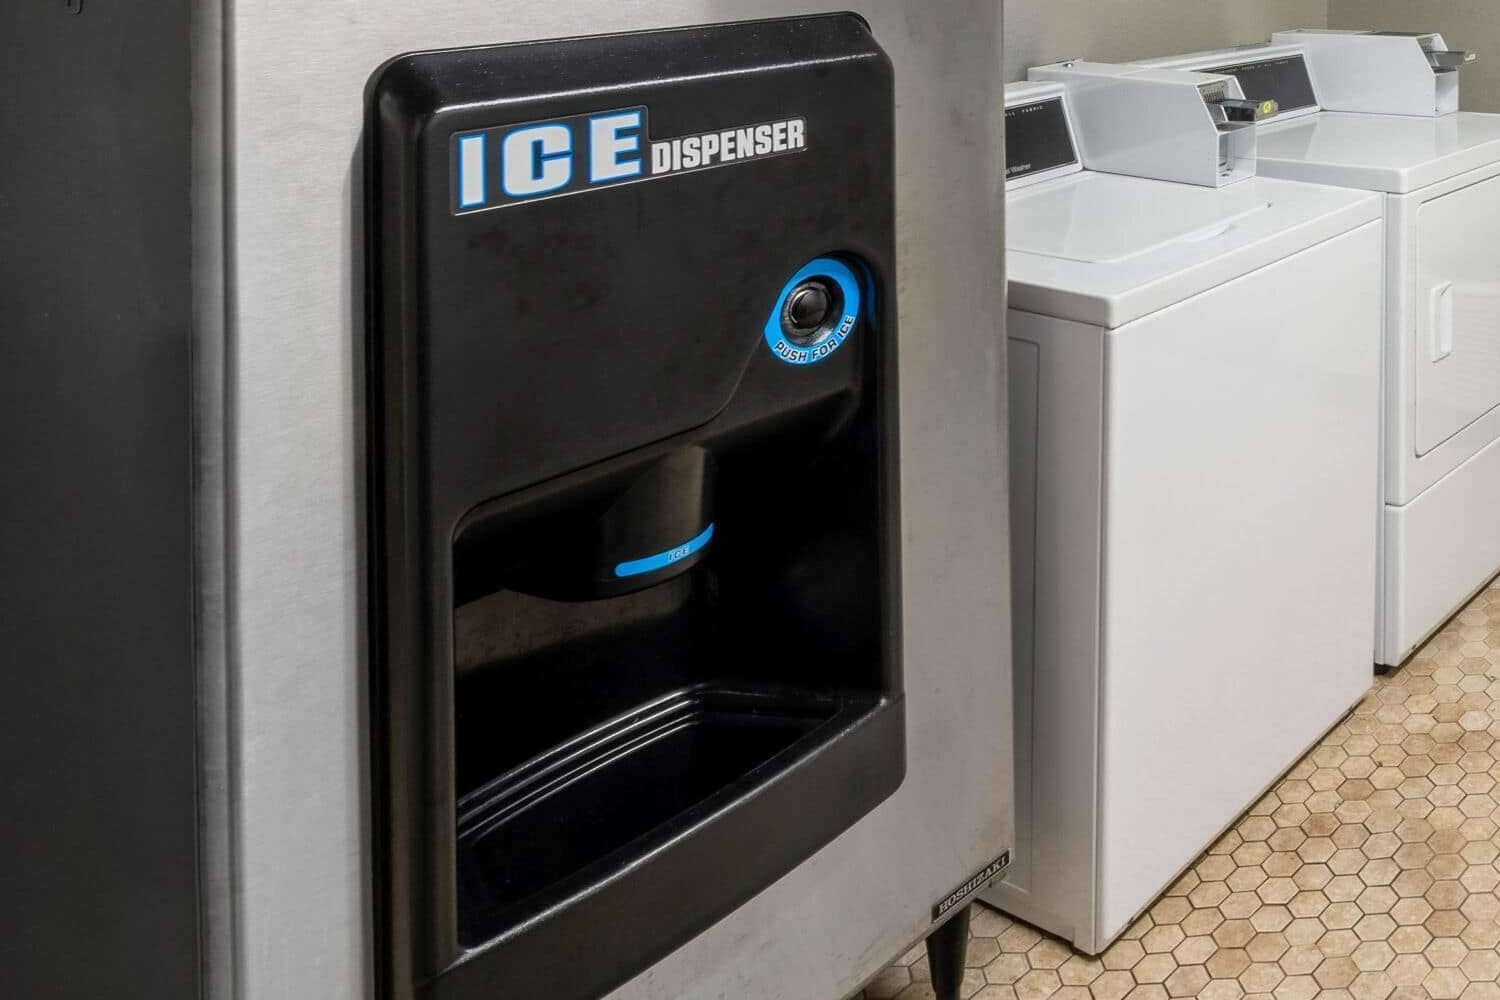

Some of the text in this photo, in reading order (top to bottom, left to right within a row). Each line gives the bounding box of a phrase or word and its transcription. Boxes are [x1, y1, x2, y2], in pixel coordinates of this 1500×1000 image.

[458, 110, 805, 209] ICE DISPENSER
[775, 314, 855, 361] PUSH FOR ICE
[938, 855, 1007, 915] HOSHIZAKI
